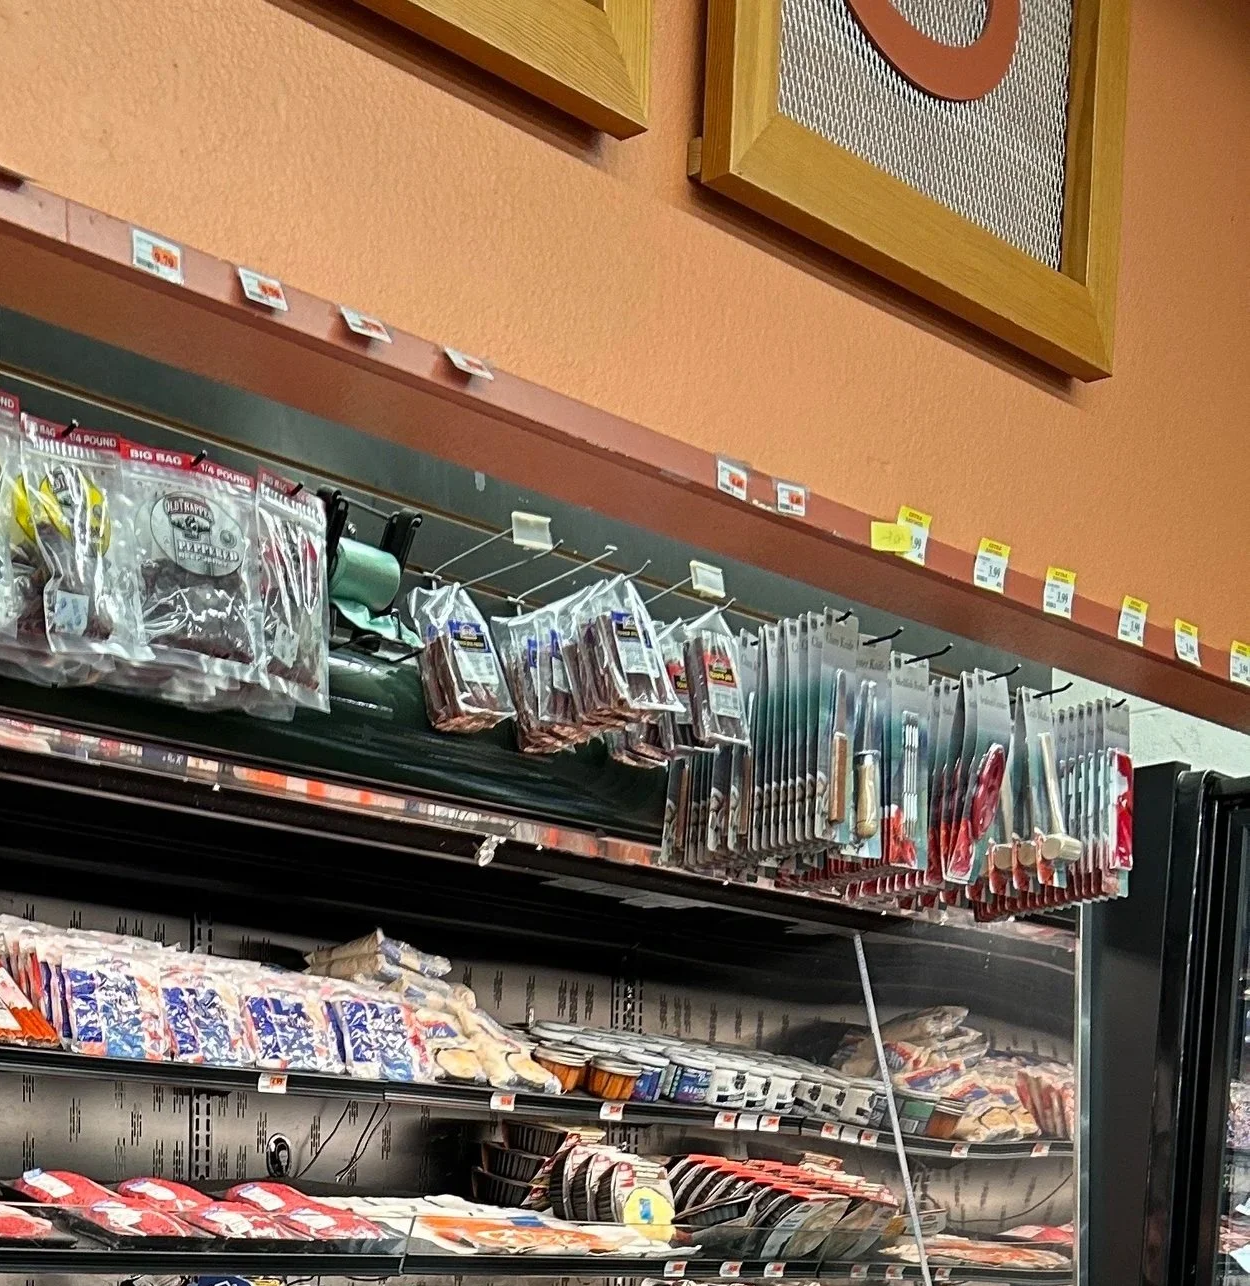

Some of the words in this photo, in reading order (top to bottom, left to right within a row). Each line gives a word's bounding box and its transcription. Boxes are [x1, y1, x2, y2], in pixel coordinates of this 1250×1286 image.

[83, 434, 118, 448] POUND
[129, 449, 153, 461] BIG
[155, 453, 183, 467] BAG
[200, 463, 215, 477] 1/4
[216, 468, 252, 488] POUND
[178, 540, 240, 562] PEPPERED
